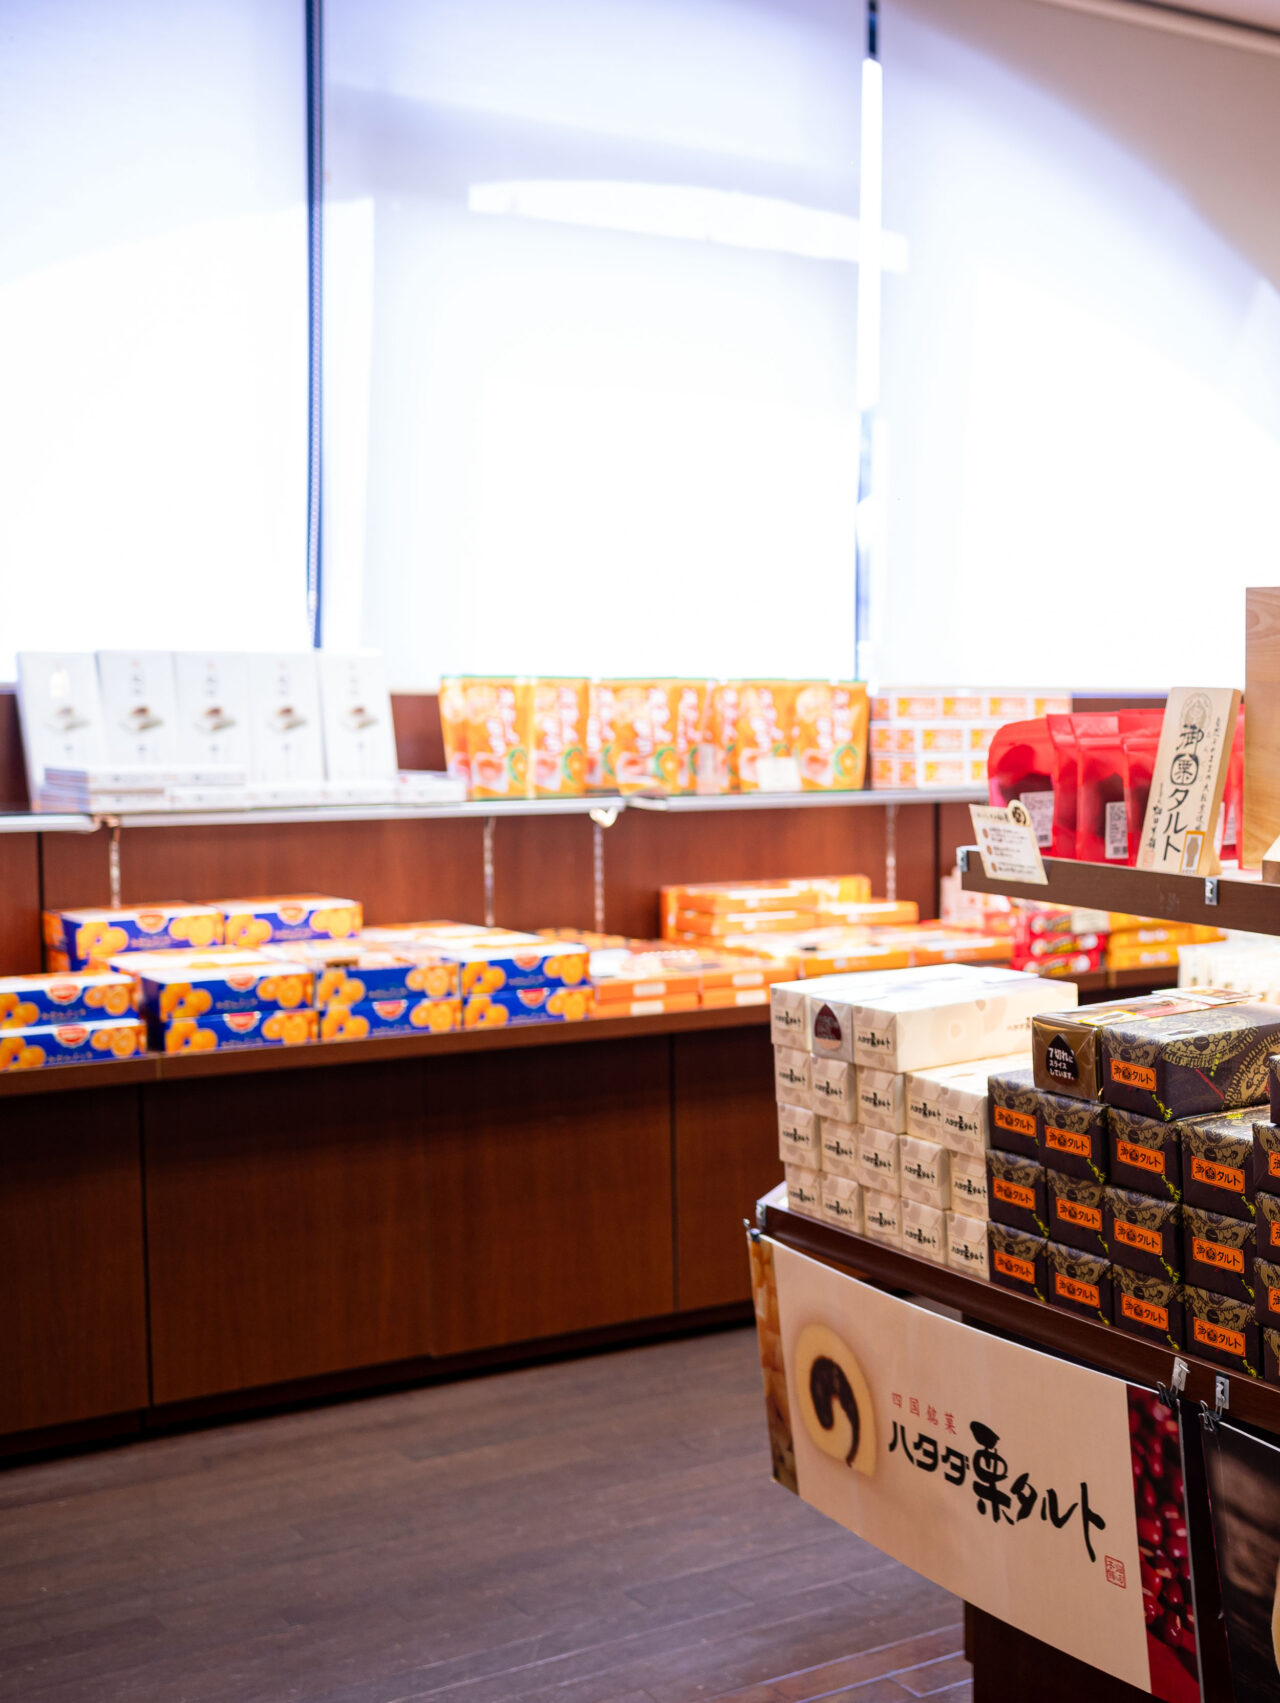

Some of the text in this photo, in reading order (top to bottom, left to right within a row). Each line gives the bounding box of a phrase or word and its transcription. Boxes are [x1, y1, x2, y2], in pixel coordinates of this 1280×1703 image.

[1048, 1046, 1074, 1064] 7切れに
[1049, 1057, 1068, 1069] スライス
[891, 1391, 957, 1436] 四国銘菓
[888, 1420, 1106, 1563] ハタダ栗タルト
